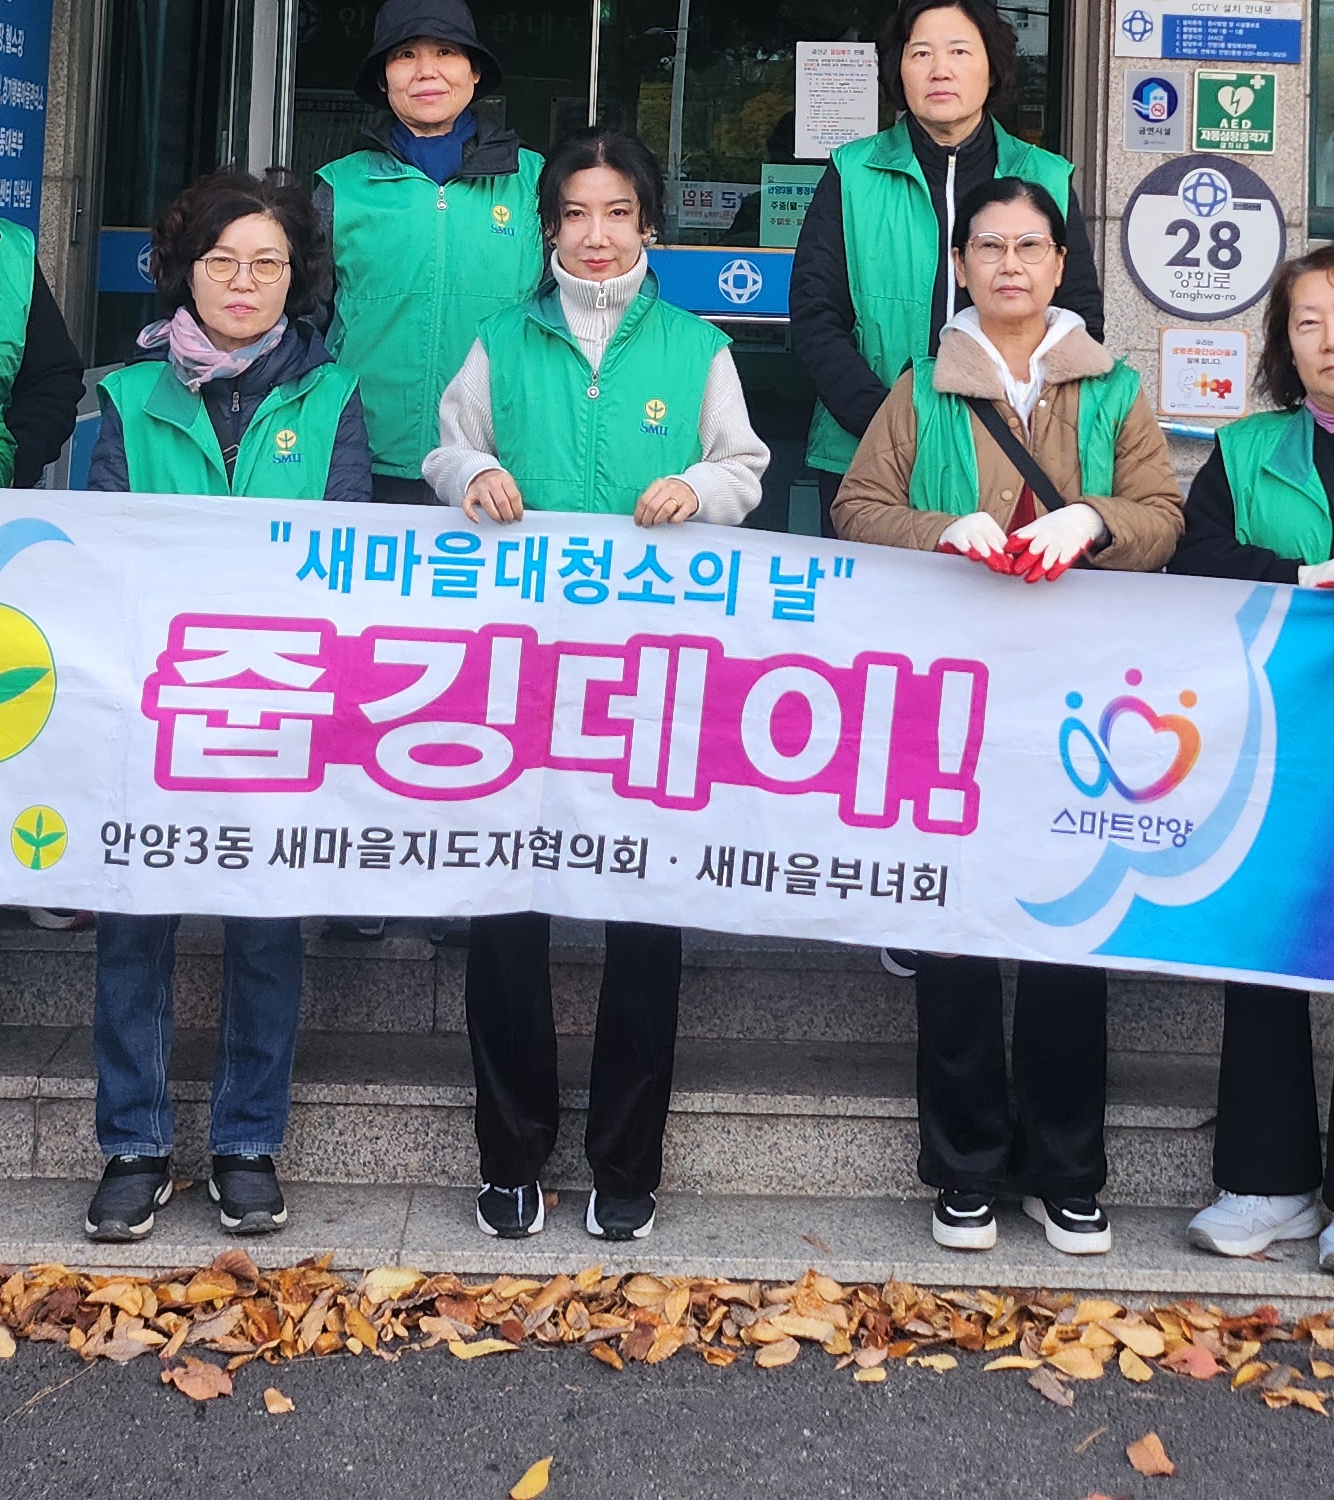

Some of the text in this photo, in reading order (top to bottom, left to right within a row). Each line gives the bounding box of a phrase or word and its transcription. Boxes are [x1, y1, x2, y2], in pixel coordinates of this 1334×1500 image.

[1191, 3, 1219, 13] CCTV
[1223, 3, 1241, 14] 설치
[1137, 126, 1172, 137] 금연시설
[1219, 118, 1252, 129] AED
[1164, 218, 1242, 271] 28
[1174, 270, 1231, 290] 양화로
[1169, 289, 1237, 302] Yanghwa-ro
[640, 421, 668, 437] SMU
[272, 453, 302, 464] SMU
[269, 520, 857, 623] "새마을대청소의 날"
[149, 618, 985, 832] 줍깅데이!
[1051, 808, 1194, 848] 스마트안양
[99, 821, 949, 907] 안양3동 새마을지도자협의회 새마을부녀회
